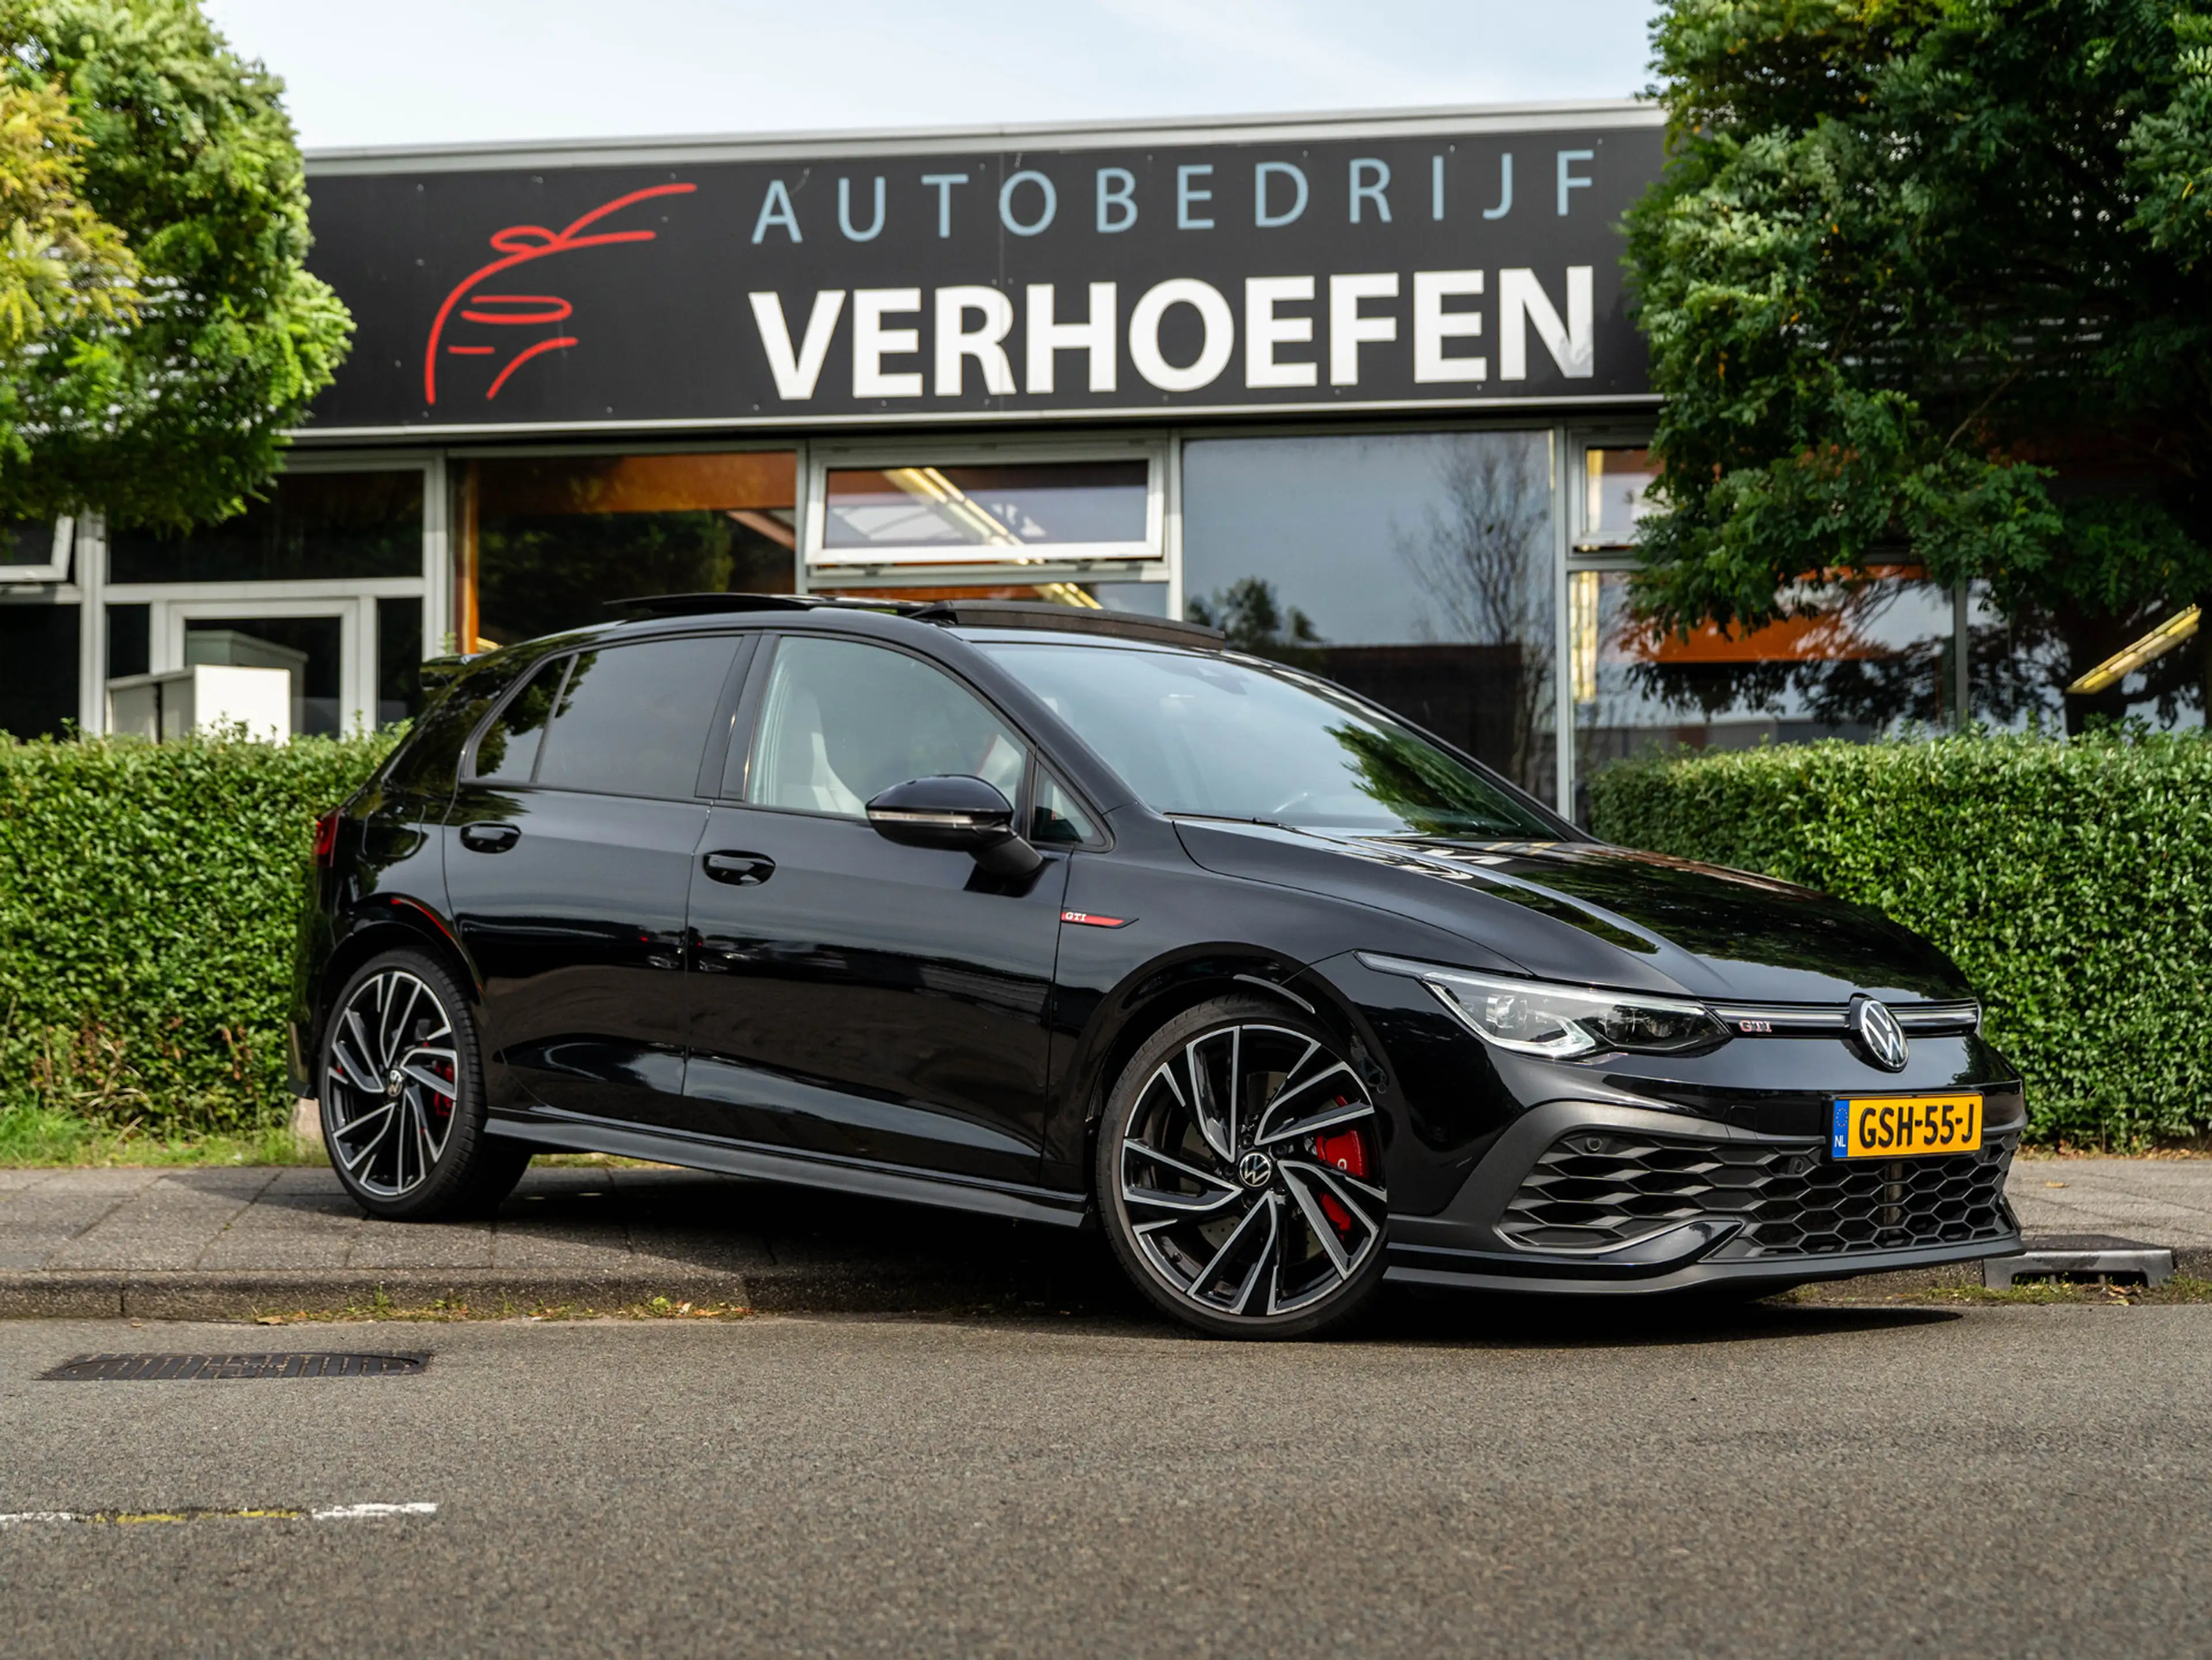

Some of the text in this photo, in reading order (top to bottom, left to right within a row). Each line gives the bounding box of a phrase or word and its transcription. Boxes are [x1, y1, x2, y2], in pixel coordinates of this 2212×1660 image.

[752, 150, 1595, 243] AUTOBEDRIJF
[749, 266, 1594, 400] VERHOEFEN
[1065, 911, 1087, 922] GTI
[1739, 1020, 1773, 1033] GTI
[1859, 1103, 1975, 1149] GSH-55-J
[1834, 1135, 1847, 1148] NL
